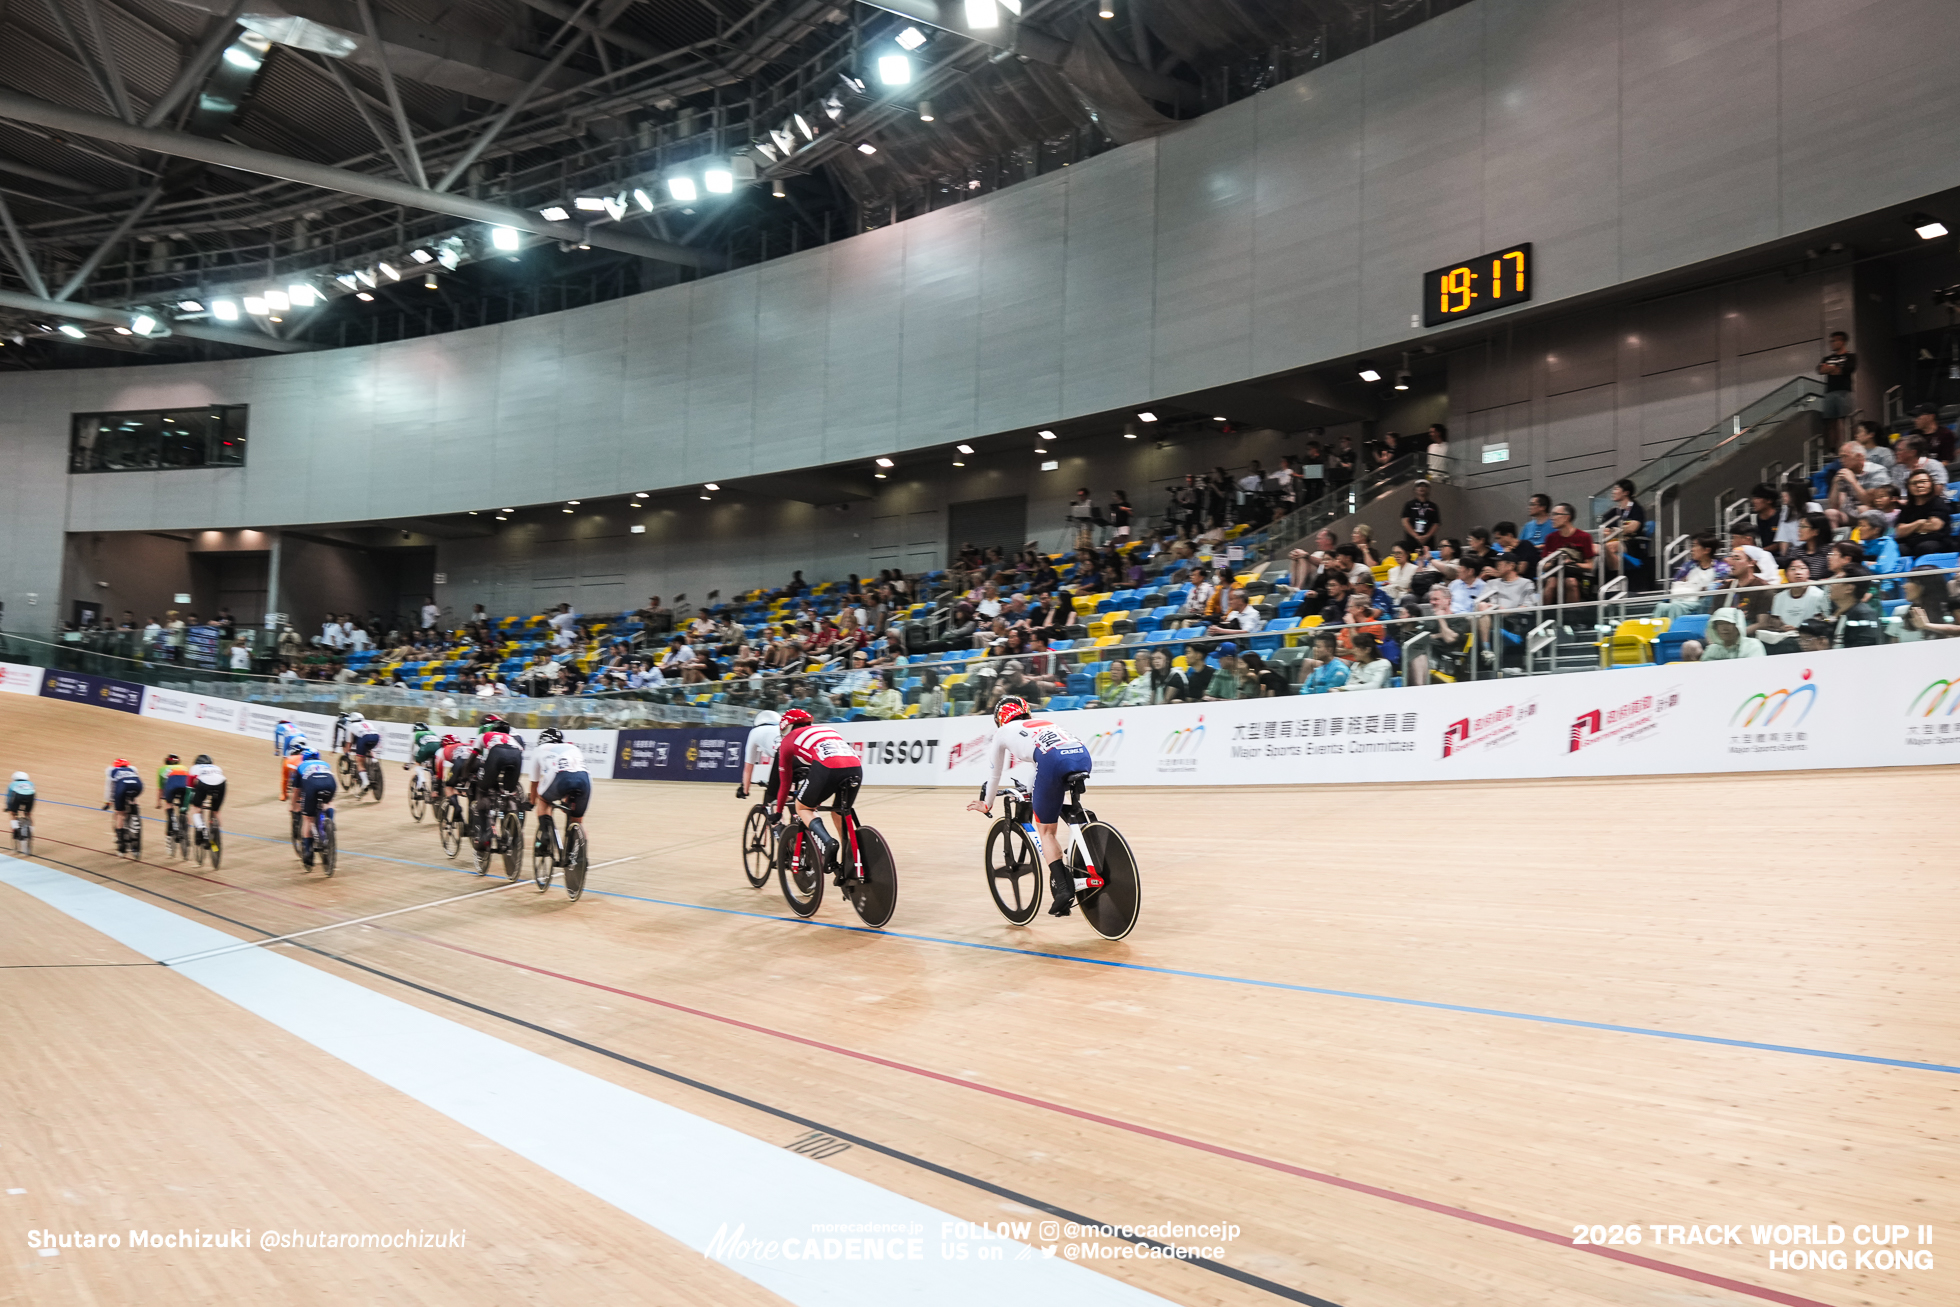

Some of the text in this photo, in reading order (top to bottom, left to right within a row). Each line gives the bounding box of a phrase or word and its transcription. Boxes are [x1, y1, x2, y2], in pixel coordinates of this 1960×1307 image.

[1441, 251, 1524, 313] 19:17
[867, 739, 939, 764] TISSOT
[1230, 740, 1416, 760] Major Sports Events Committee
[782, 1132, 852, 1160] 100
